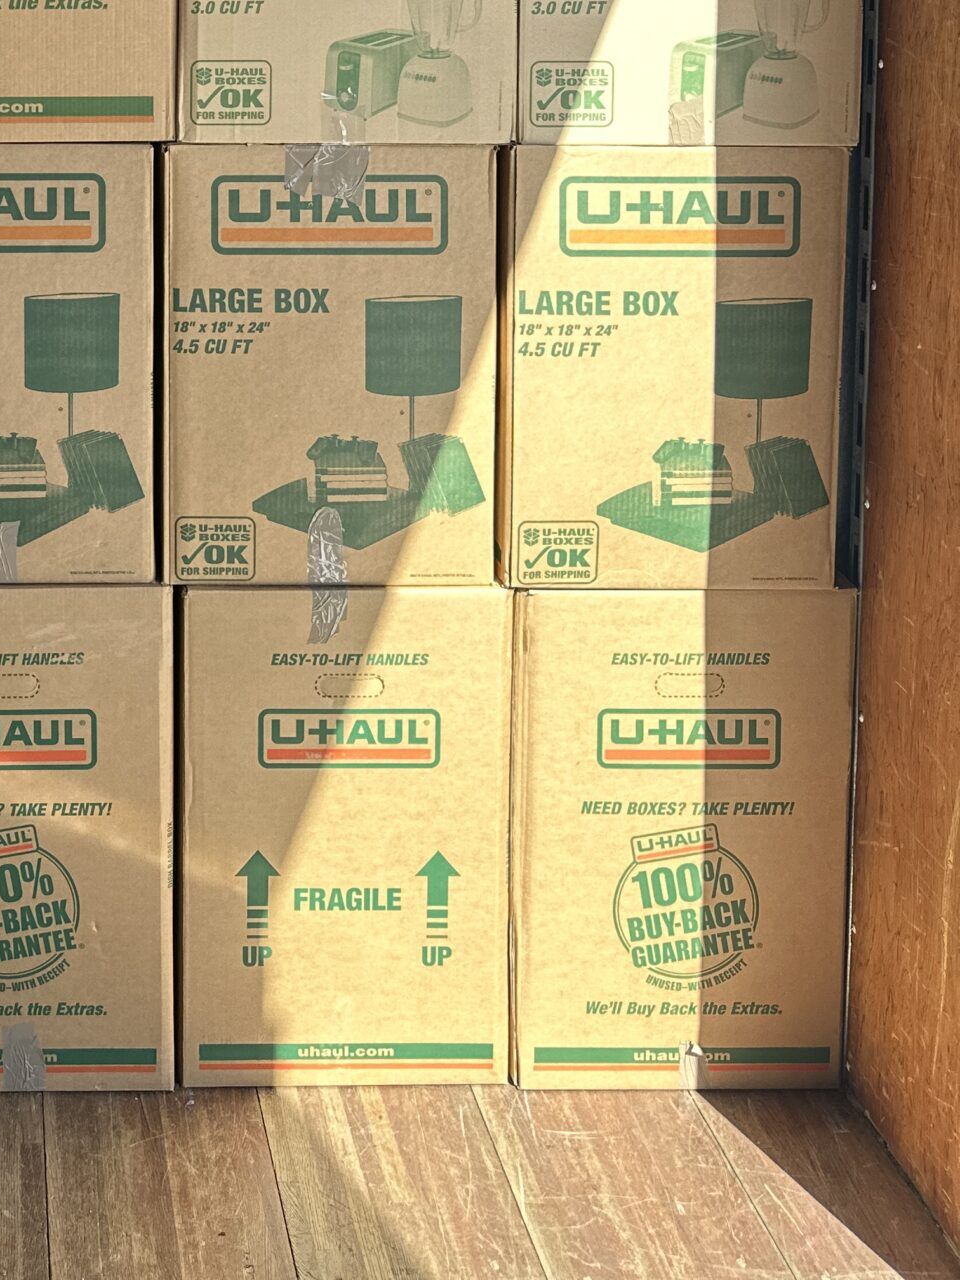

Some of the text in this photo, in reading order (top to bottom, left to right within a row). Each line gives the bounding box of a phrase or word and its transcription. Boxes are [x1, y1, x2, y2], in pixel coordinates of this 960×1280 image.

[191, 0, 264, 14] 3.0 CU FT
[577, 190, 785, 224] U-HAUL
[173, 288, 330, 313] LARGE BOX
[518, 290, 679, 316] LARGE BOX
[271, 719, 428, 745] U-HAUL
[611, 719, 770, 745] U-HAUL
[293, 887, 402, 912] FRAGILE
[297, 1045, 395, 1058] uhaul.com
